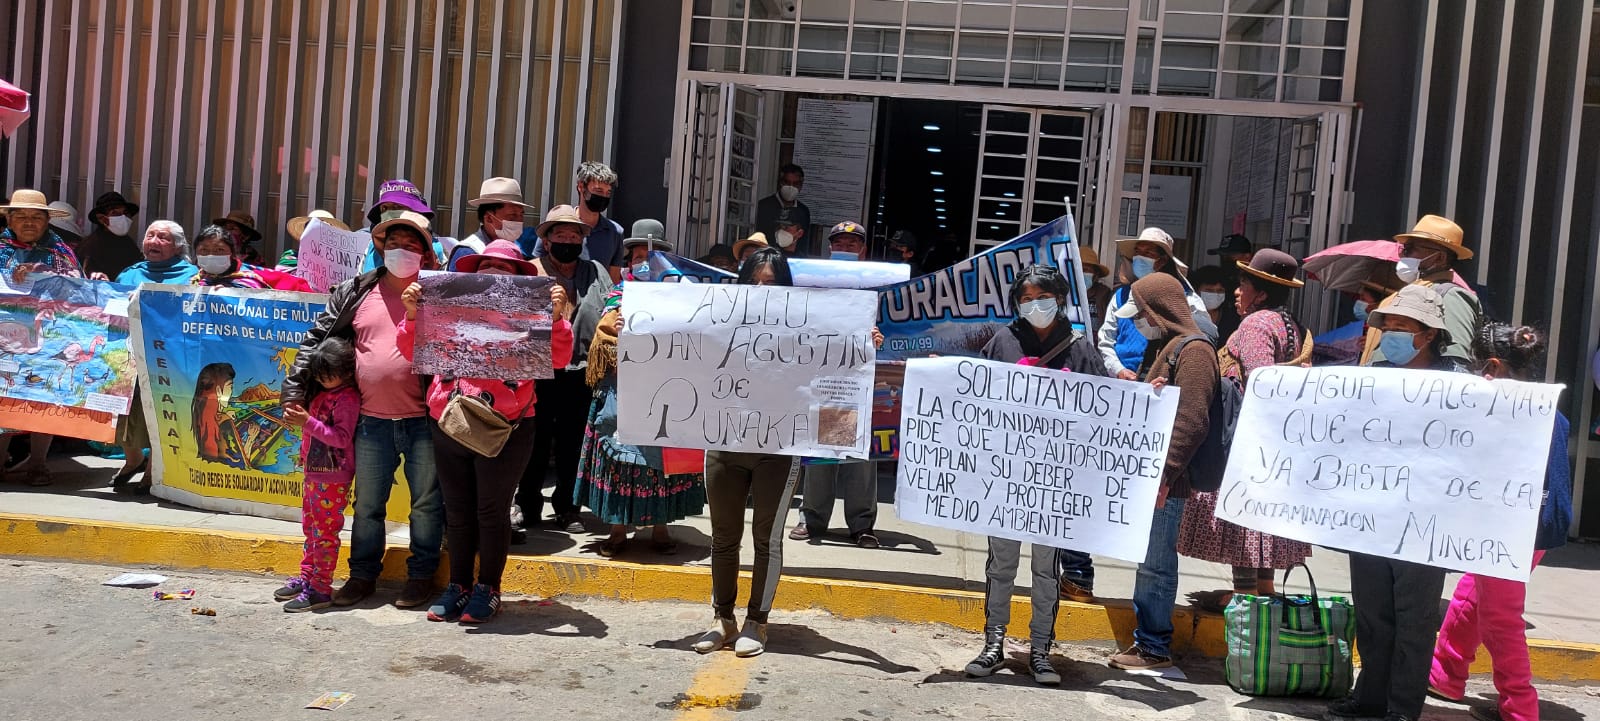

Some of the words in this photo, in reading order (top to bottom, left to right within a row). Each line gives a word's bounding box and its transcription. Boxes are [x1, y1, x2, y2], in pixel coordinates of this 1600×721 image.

[182, 300, 206, 316] RED
[210, 301, 269, 319] NACIONAL
[273, 308, 288, 321] DE
[182, 322, 239, 337] DEFENSA
[241, 326, 256, 339] DE
[258, 329, 273, 341] LA
[688, 286, 810, 329] AYLLU
[621, 310, 702, 363] SAN
[717, 326, 867, 371] AGUSTIN
[153, 340, 180, 455] RENAMAT
[711, 373, 749, 399] DE
[1252, 368, 1289, 400] EL
[1295, 367, 1377, 406] AGUA
[1402, 378, 1477, 410] VALE
[917, 387, 944, 419] LA
[1088, 423, 1165, 453] YURACARI
[1362, 417, 1403, 446] EL
[904, 440, 977, 474] CUMPLAN
[990, 454, 1012, 480] SU
[1023, 460, 1074, 491] DEBER
[1105, 476, 1130, 500] DE
[906, 417, 942, 444] PIDE
[957, 424, 993, 453] QUE
[1005, 432, 1036, 459] LAS
[1043, 438, 1161, 479] AUTORIDADES
[207, 471, 223, 489] REDES
[225, 473, 231, 489] DE
[904, 464, 956, 495] VELAR
[980, 477, 994, 500] Y
[1006, 481, 1093, 518] PROTEGER
[1108, 500, 1130, 526] EL
[1250, 446, 1293, 485] YA
[1305, 454, 1411, 503] BASTA
[1446, 479, 1483, 501] DE
[1501, 479, 1535, 510] LA
[925, 493, 980, 523] MEDIO
[987, 504, 1074, 540] AMBIENTE
[1223, 480, 1377, 534] CONTAMINACION
[1392, 511, 1520, 569] MINERA
